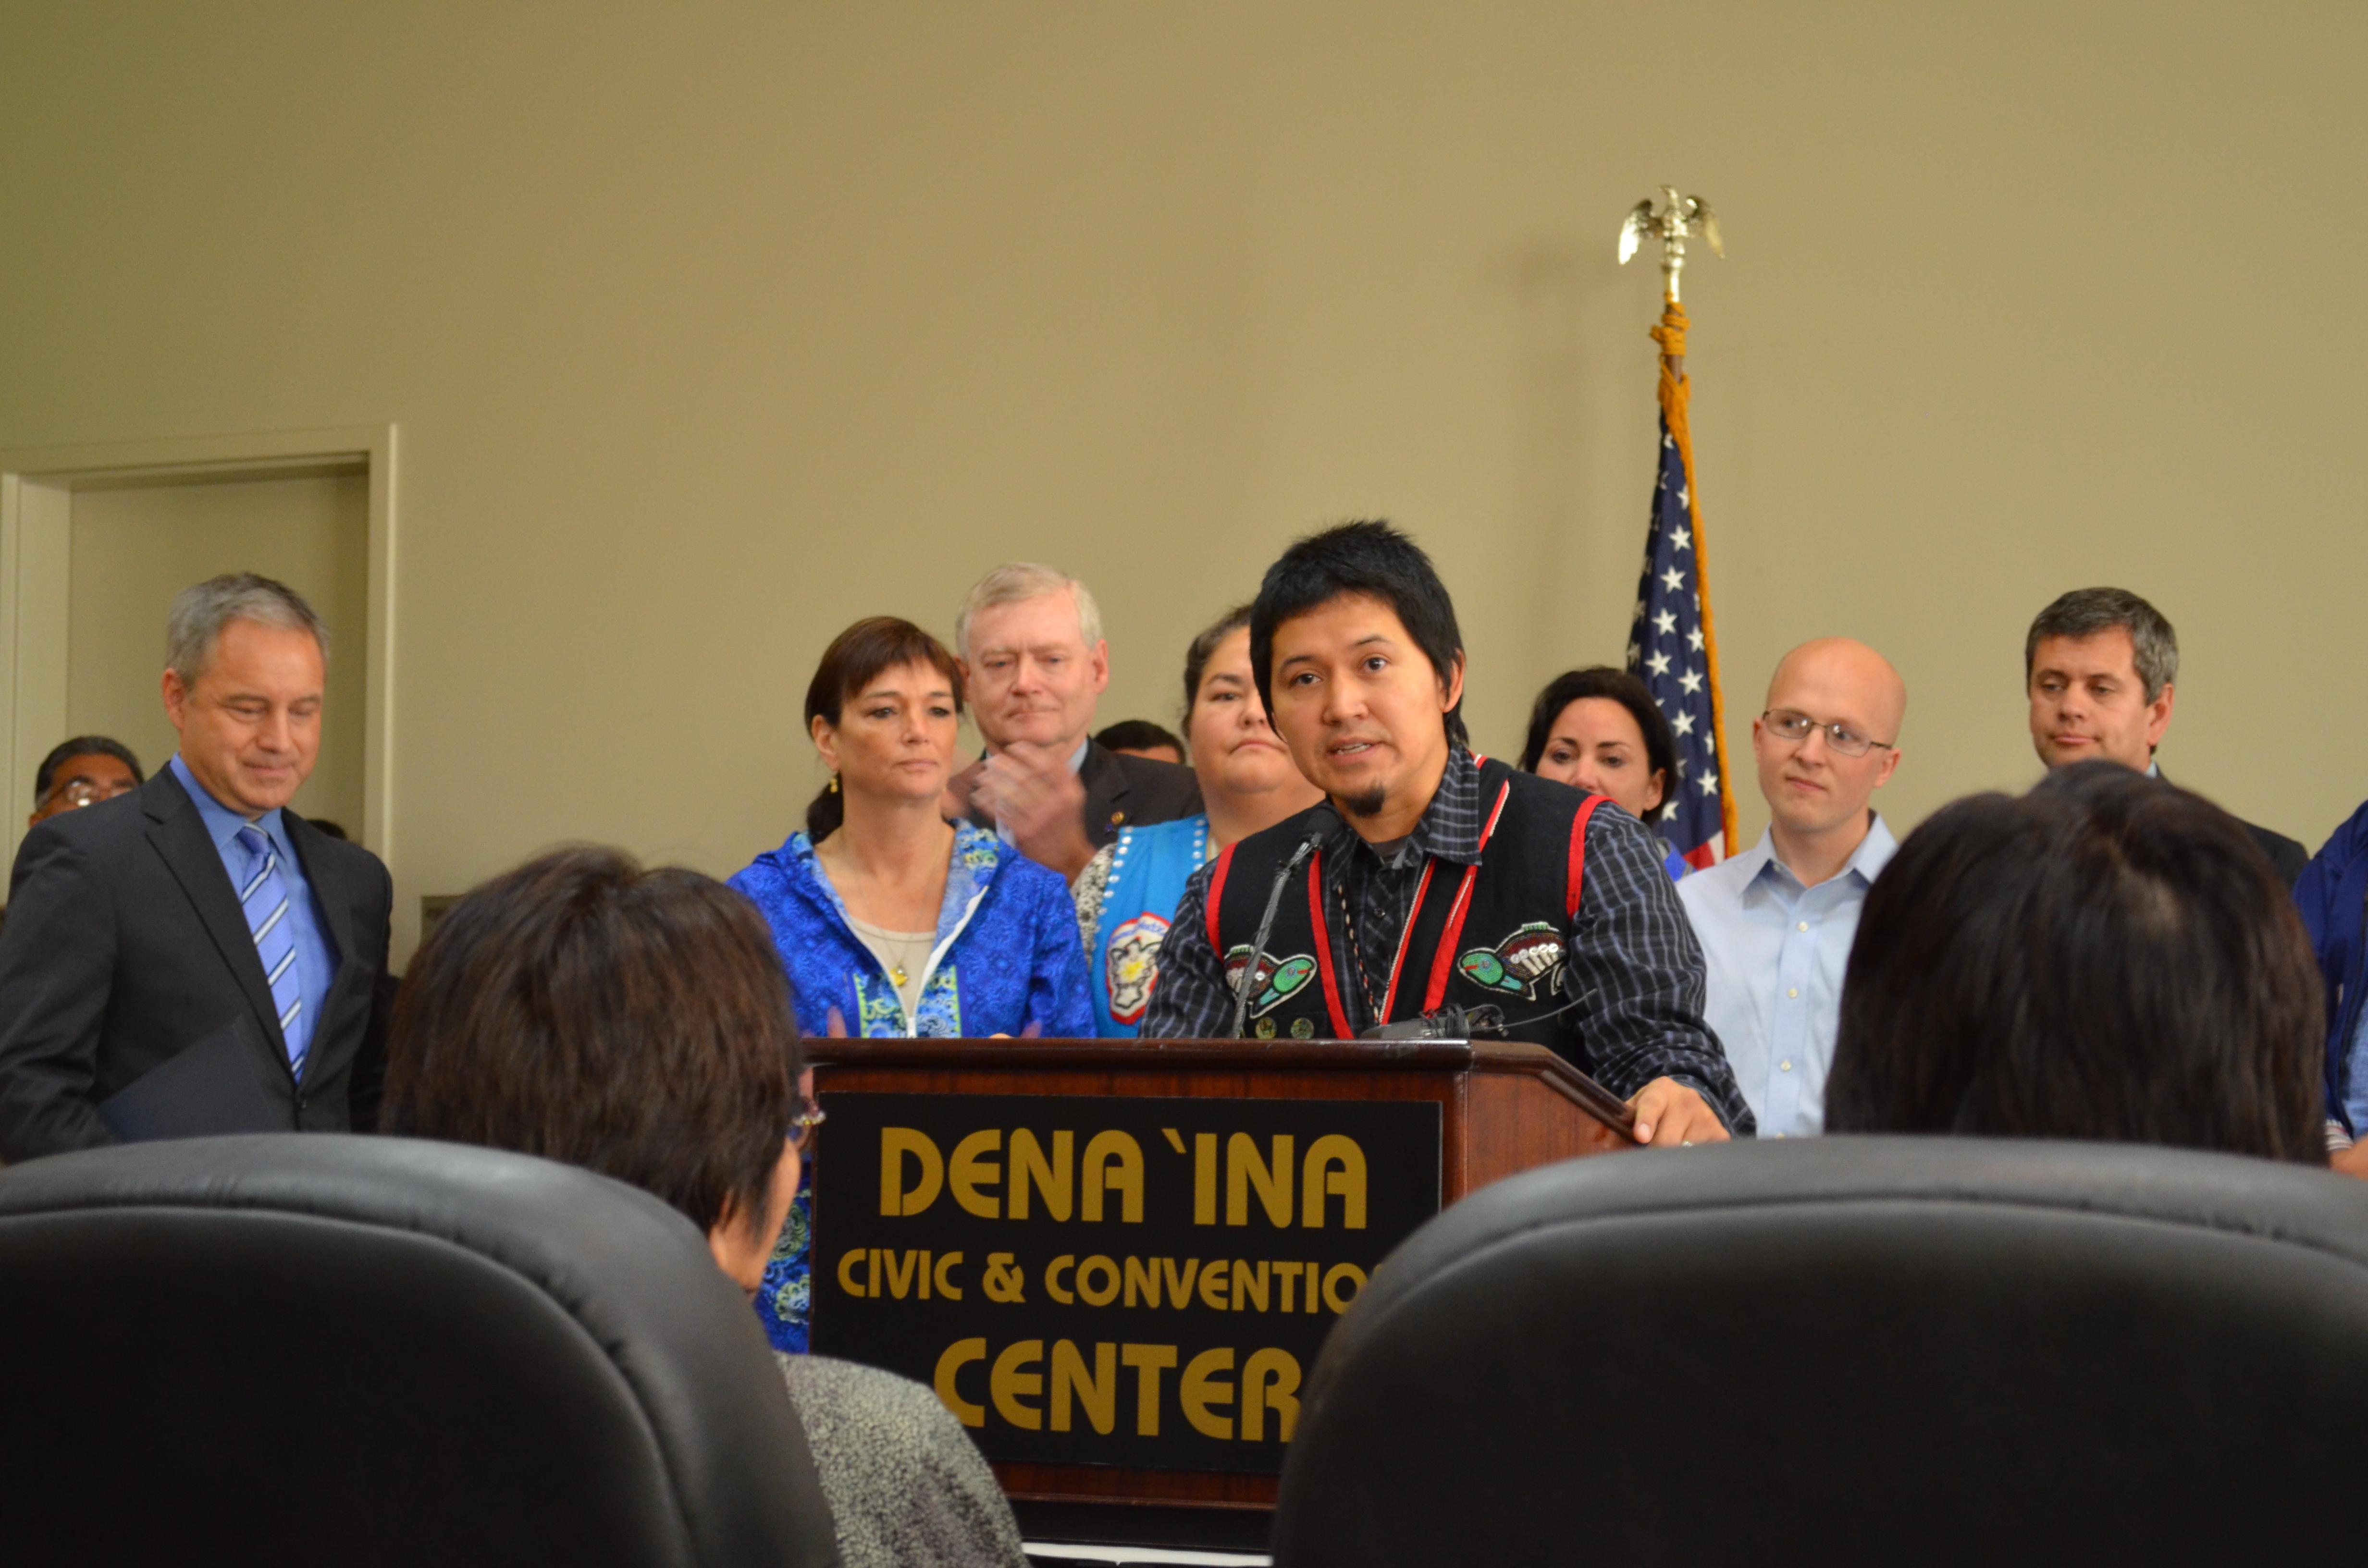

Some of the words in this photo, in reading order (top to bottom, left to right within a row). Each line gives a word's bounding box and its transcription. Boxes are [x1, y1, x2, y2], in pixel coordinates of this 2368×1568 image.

[880, 1127, 1145, 1223] DENA
[838, 1248, 963, 1300] CIVIC
[982, 1252, 1025, 1303] &
[1044, 1254, 1384, 1315] CONVENTIO
[934, 1337, 1302, 1443] CENTER
